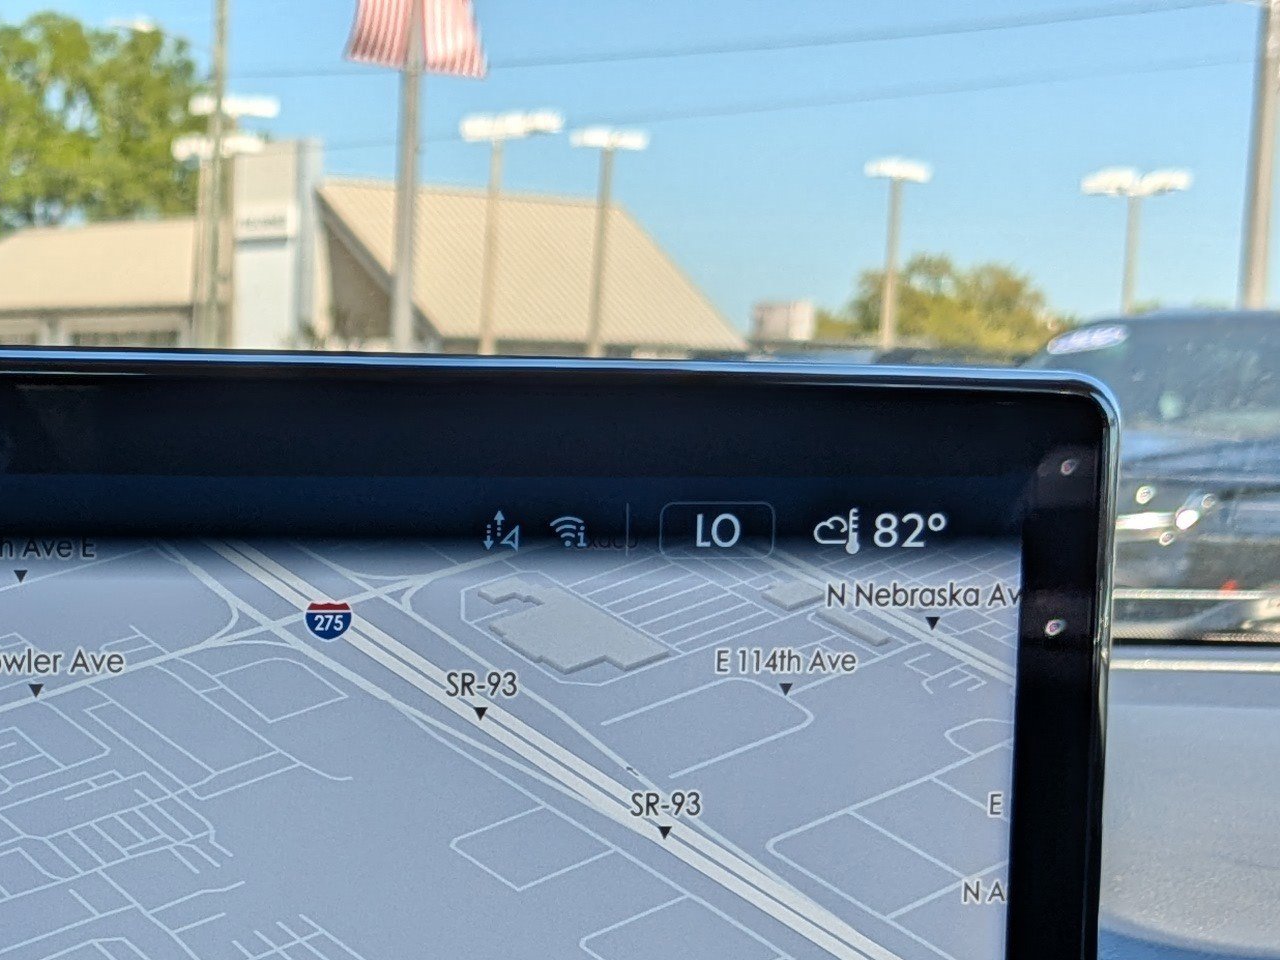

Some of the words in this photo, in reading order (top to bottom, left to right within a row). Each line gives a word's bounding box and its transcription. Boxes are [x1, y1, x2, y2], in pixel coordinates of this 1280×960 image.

[695, 513, 741, 548] LO
[22, 536, 73, 558] Ave
[81, 537, 95, 558] E
[827, 582, 846, 607] N
[854, 582, 980, 607] Nebraska
[313, 614, 344, 632] 275
[70, 649, 125, 675] Ave
[716, 649, 730, 673] E
[739, 648, 801, 673] 114th
[808, 649, 858, 673] Ave
[445, 671, 518, 698] SR-93
[630, 791, 702, 818] SR-93
[989, 793, 1002, 815] E
[963, 881, 980, 902] N
